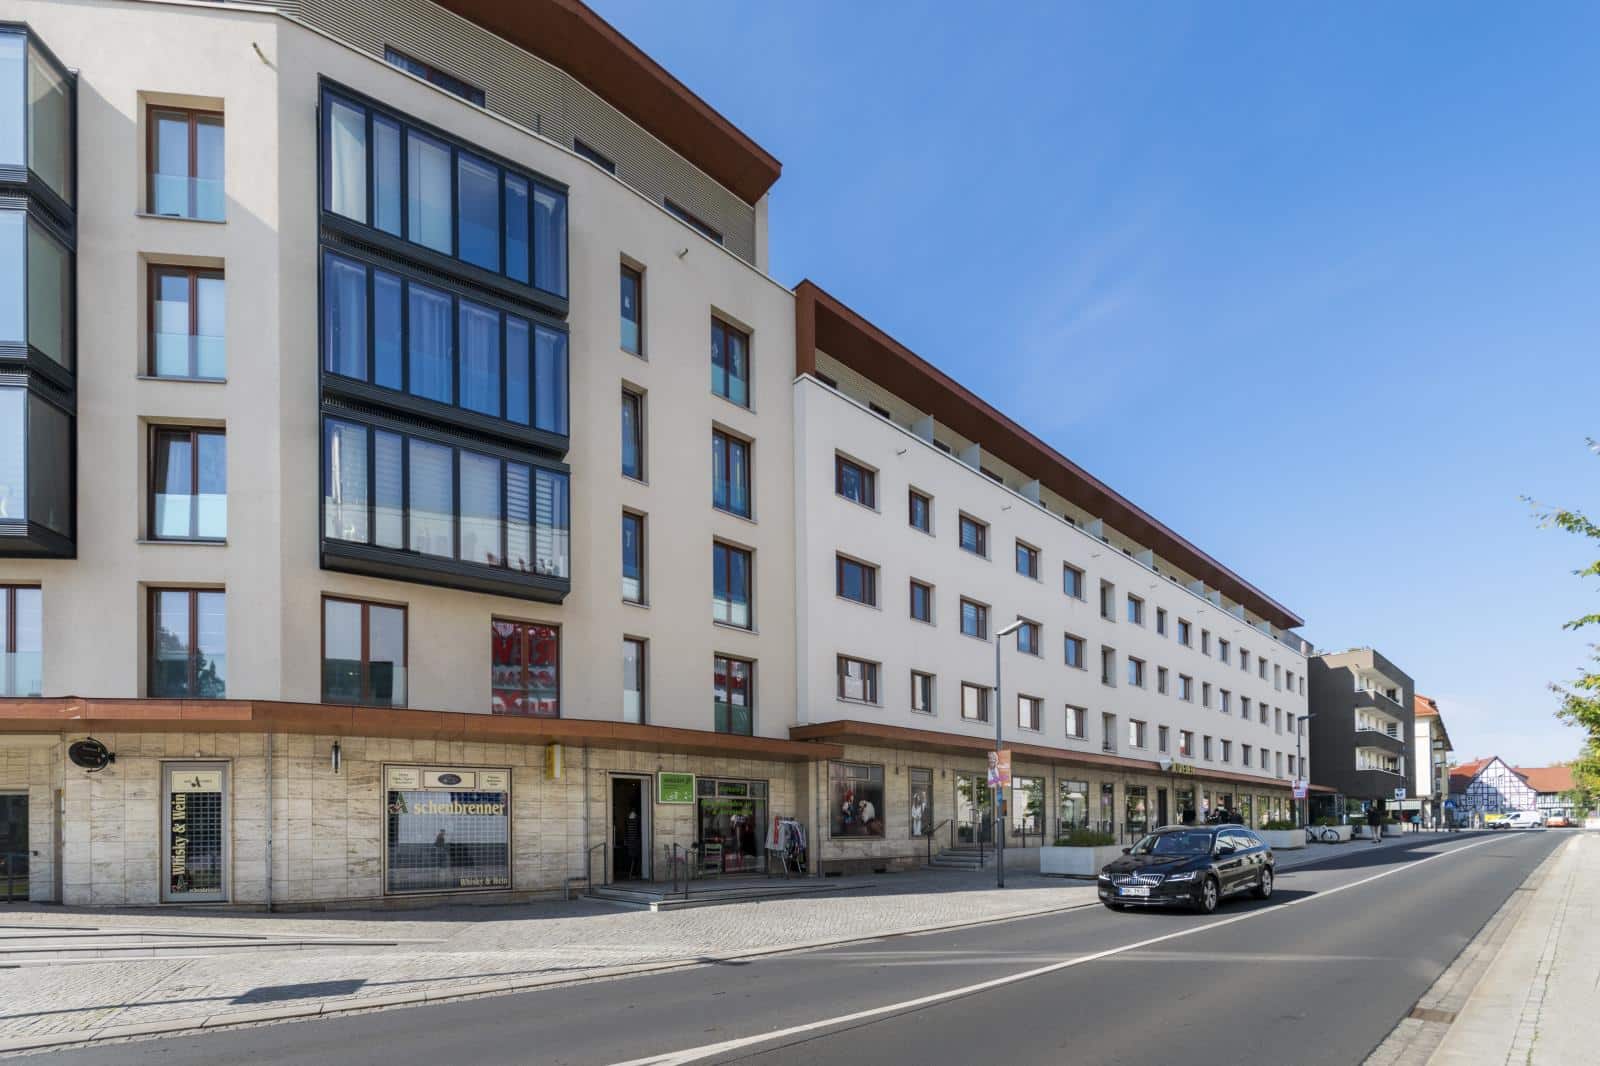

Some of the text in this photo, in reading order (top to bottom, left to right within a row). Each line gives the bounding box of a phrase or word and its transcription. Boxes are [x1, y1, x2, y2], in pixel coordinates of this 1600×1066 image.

[172, 793, 189, 875] Whisky & Wein
